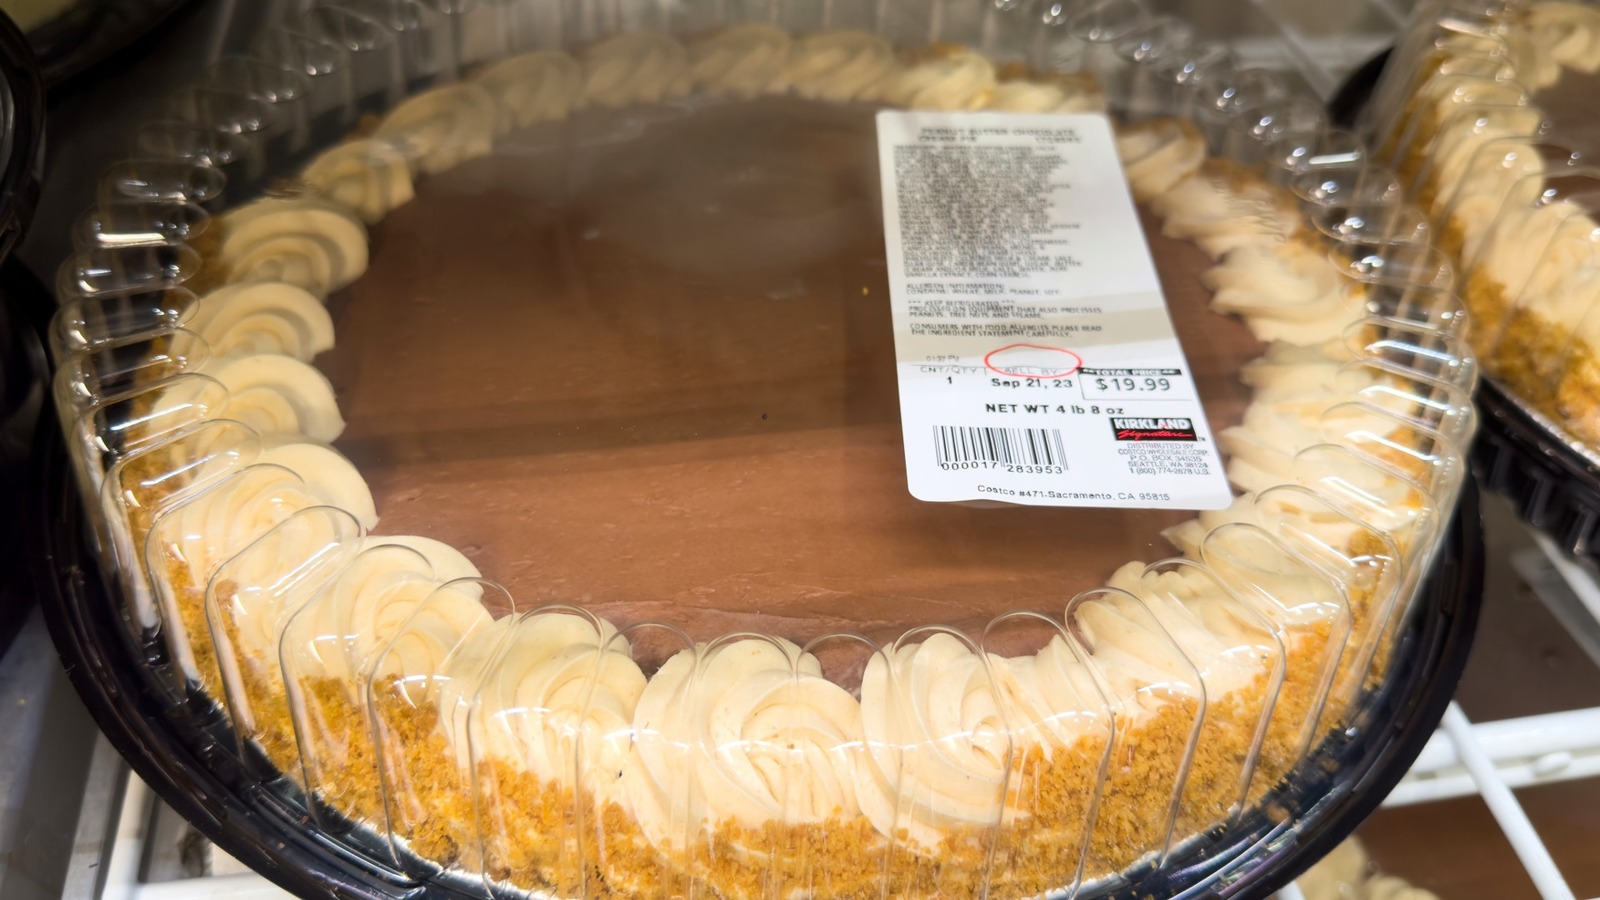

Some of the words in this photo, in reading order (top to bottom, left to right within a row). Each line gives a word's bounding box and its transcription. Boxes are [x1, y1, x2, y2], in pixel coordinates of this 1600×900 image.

[909, 323, 958, 331] CONSUMERS
[920, 366, 977, 375] CNT/QTY
[946, 376, 952, 384] 1
[991, 378, 1021, 389] Sep
[1025, 378, 1048, 390] 21,
[1053, 379, 1073, 388] 23
[1095, 377, 1170, 391] $19.99
[985, 403, 1018, 414] NET
[1024, 404, 1049, 414] WT
[1056, 405, 1066, 414] 4
[1071, 405, 1085, 414] lb
[1090, 405, 1100, 414] 8
[1105, 407, 1124, 415] oz
[1113, 418, 1191, 430] KIRKLAND
[1116, 429, 1193, 441] Signature
[940, 460, 998, 471] 000017
[1006, 464, 1063, 474] 283953
[1136, 467, 1156, 475] (800)
[977, 485, 1015, 496] Costco
[1118, 492, 1136, 500] CA
[1139, 492, 1170, 501] 95815
